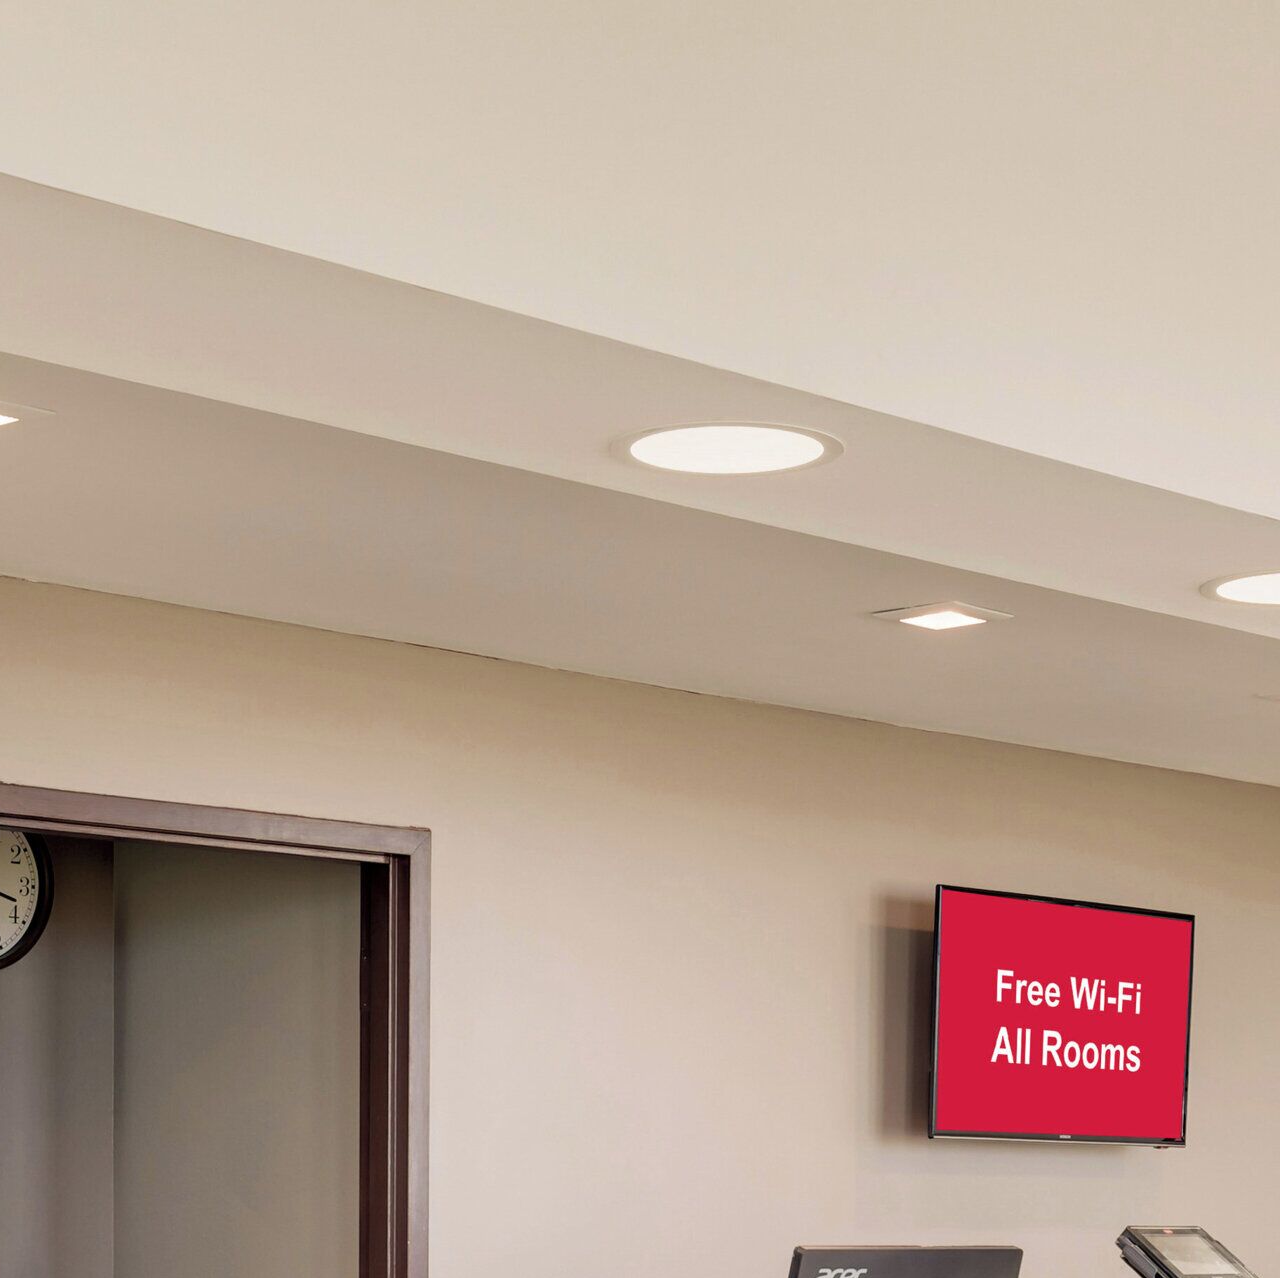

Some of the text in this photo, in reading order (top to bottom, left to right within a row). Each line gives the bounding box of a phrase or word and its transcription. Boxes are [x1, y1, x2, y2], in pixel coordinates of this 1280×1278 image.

[10, 844, 21, 864] 2
[19, 876, 30, 897] 3
[8, 904, 20, 924] 4
[996, 968, 1142, 1015] Free Wi-Fi
[990, 1026, 1141, 1073] All Rooms
